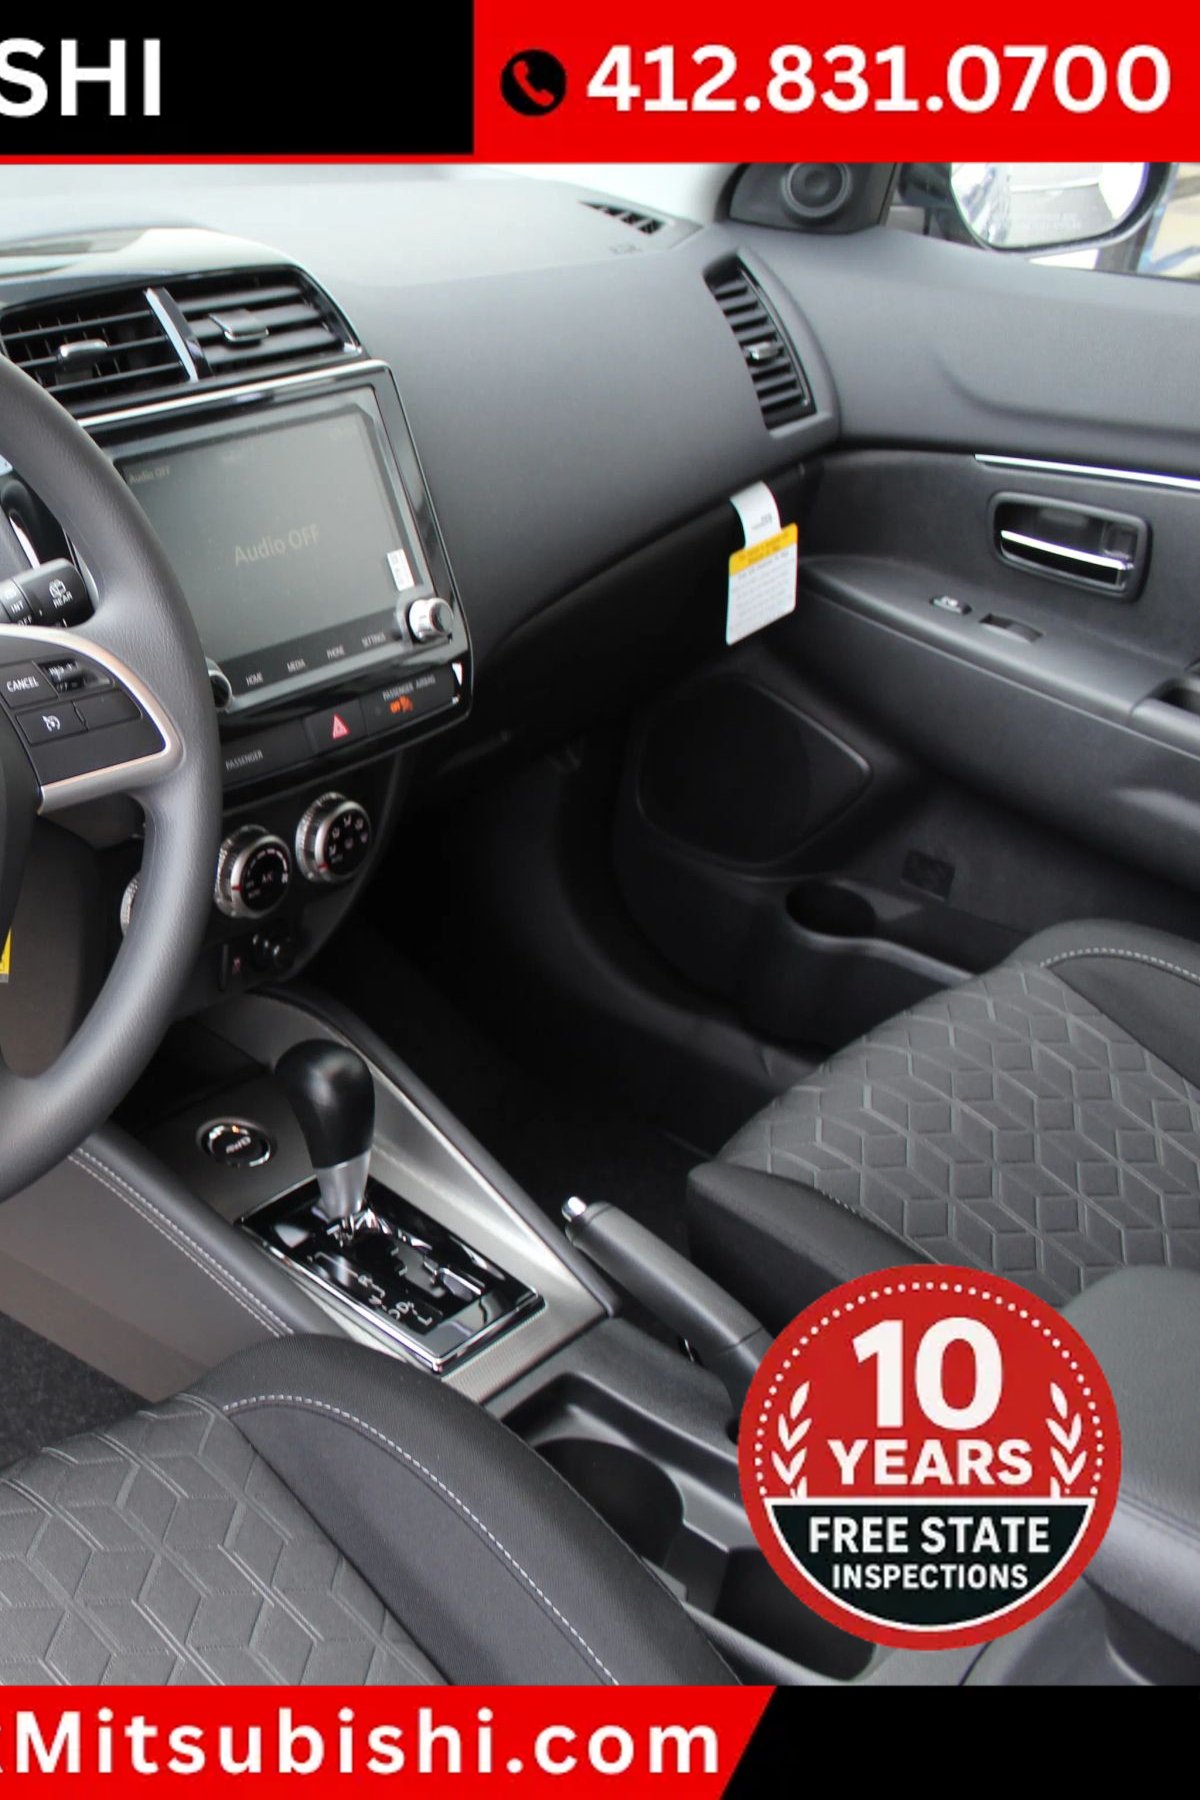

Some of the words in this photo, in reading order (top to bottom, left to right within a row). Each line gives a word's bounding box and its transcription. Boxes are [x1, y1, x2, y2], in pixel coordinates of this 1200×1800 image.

[234, 537, 286, 567] Audio
[287, 524, 320, 549] OFF
[10, 601, 24, 614] INT
[53, 592, 74, 608] REAR
[6, 675, 40, 693] CANCEL
[225, 749, 264, 771] PASSENGER
